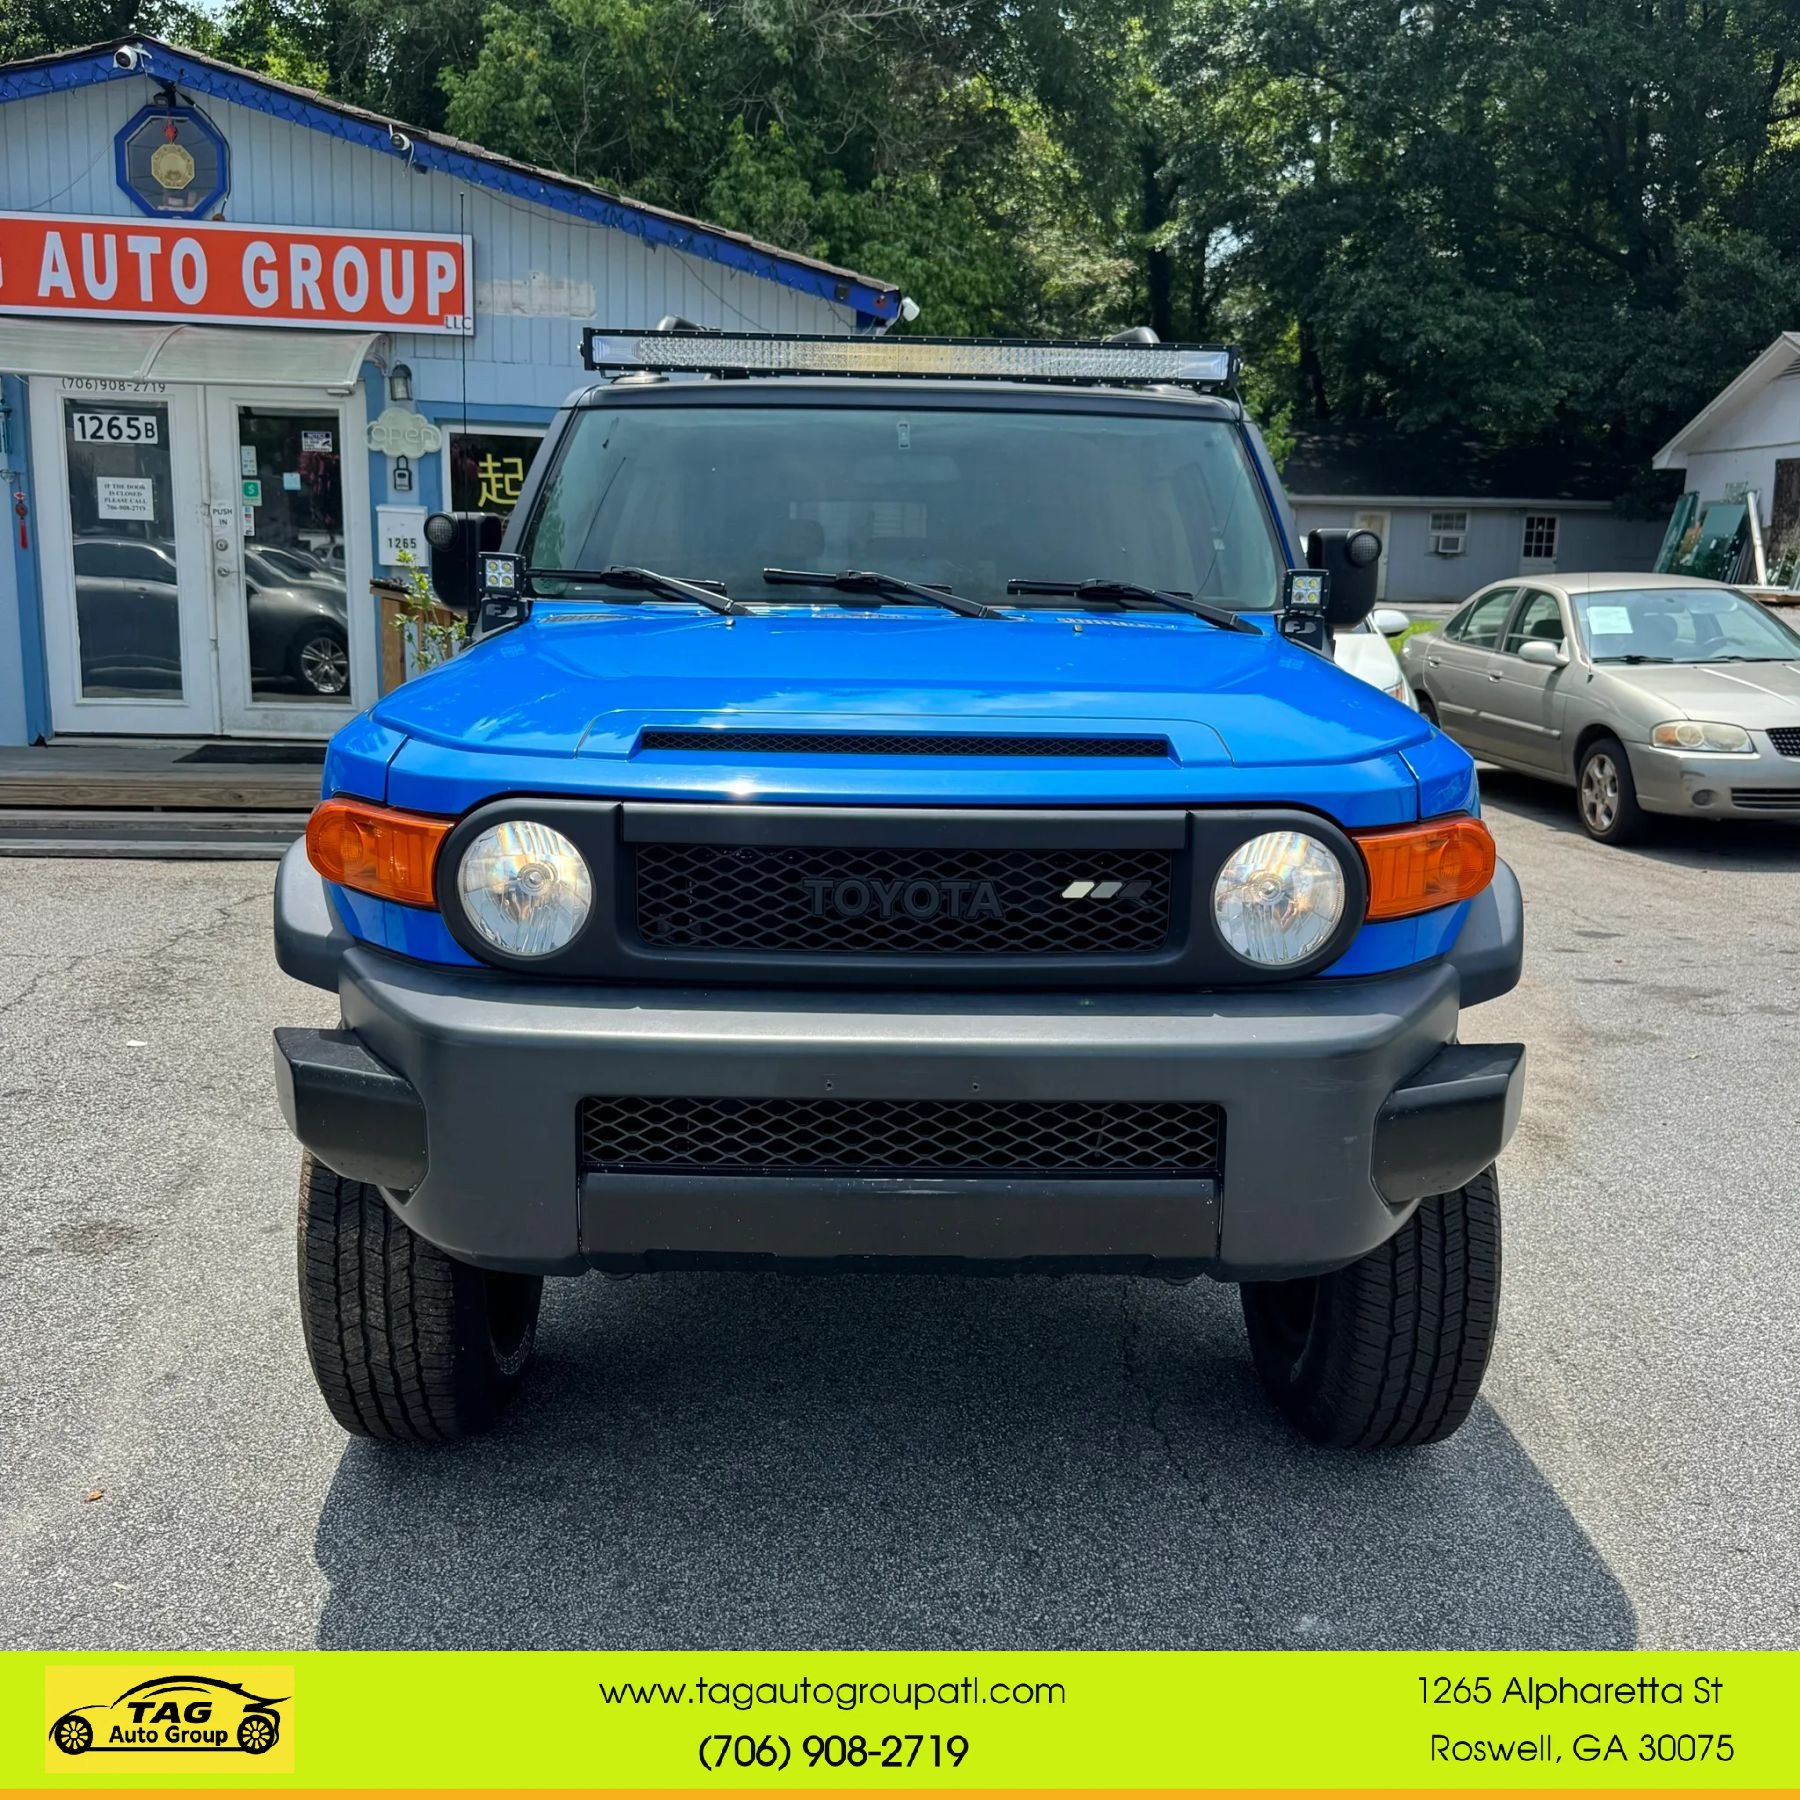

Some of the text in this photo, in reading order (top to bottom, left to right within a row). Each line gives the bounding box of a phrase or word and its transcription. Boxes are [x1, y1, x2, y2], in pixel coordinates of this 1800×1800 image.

[37, 231, 208, 306] AUTO
[242, 240, 457, 316] GROUP
[445, 316, 473, 331] LLC
[477, 452, 524, 508] 起
[212, 508, 232, 516] PUSH
[219, 518, 228, 526] IN
[387, 537, 417, 549] 1265
[802, 878, 1003, 919] TOYOTA
